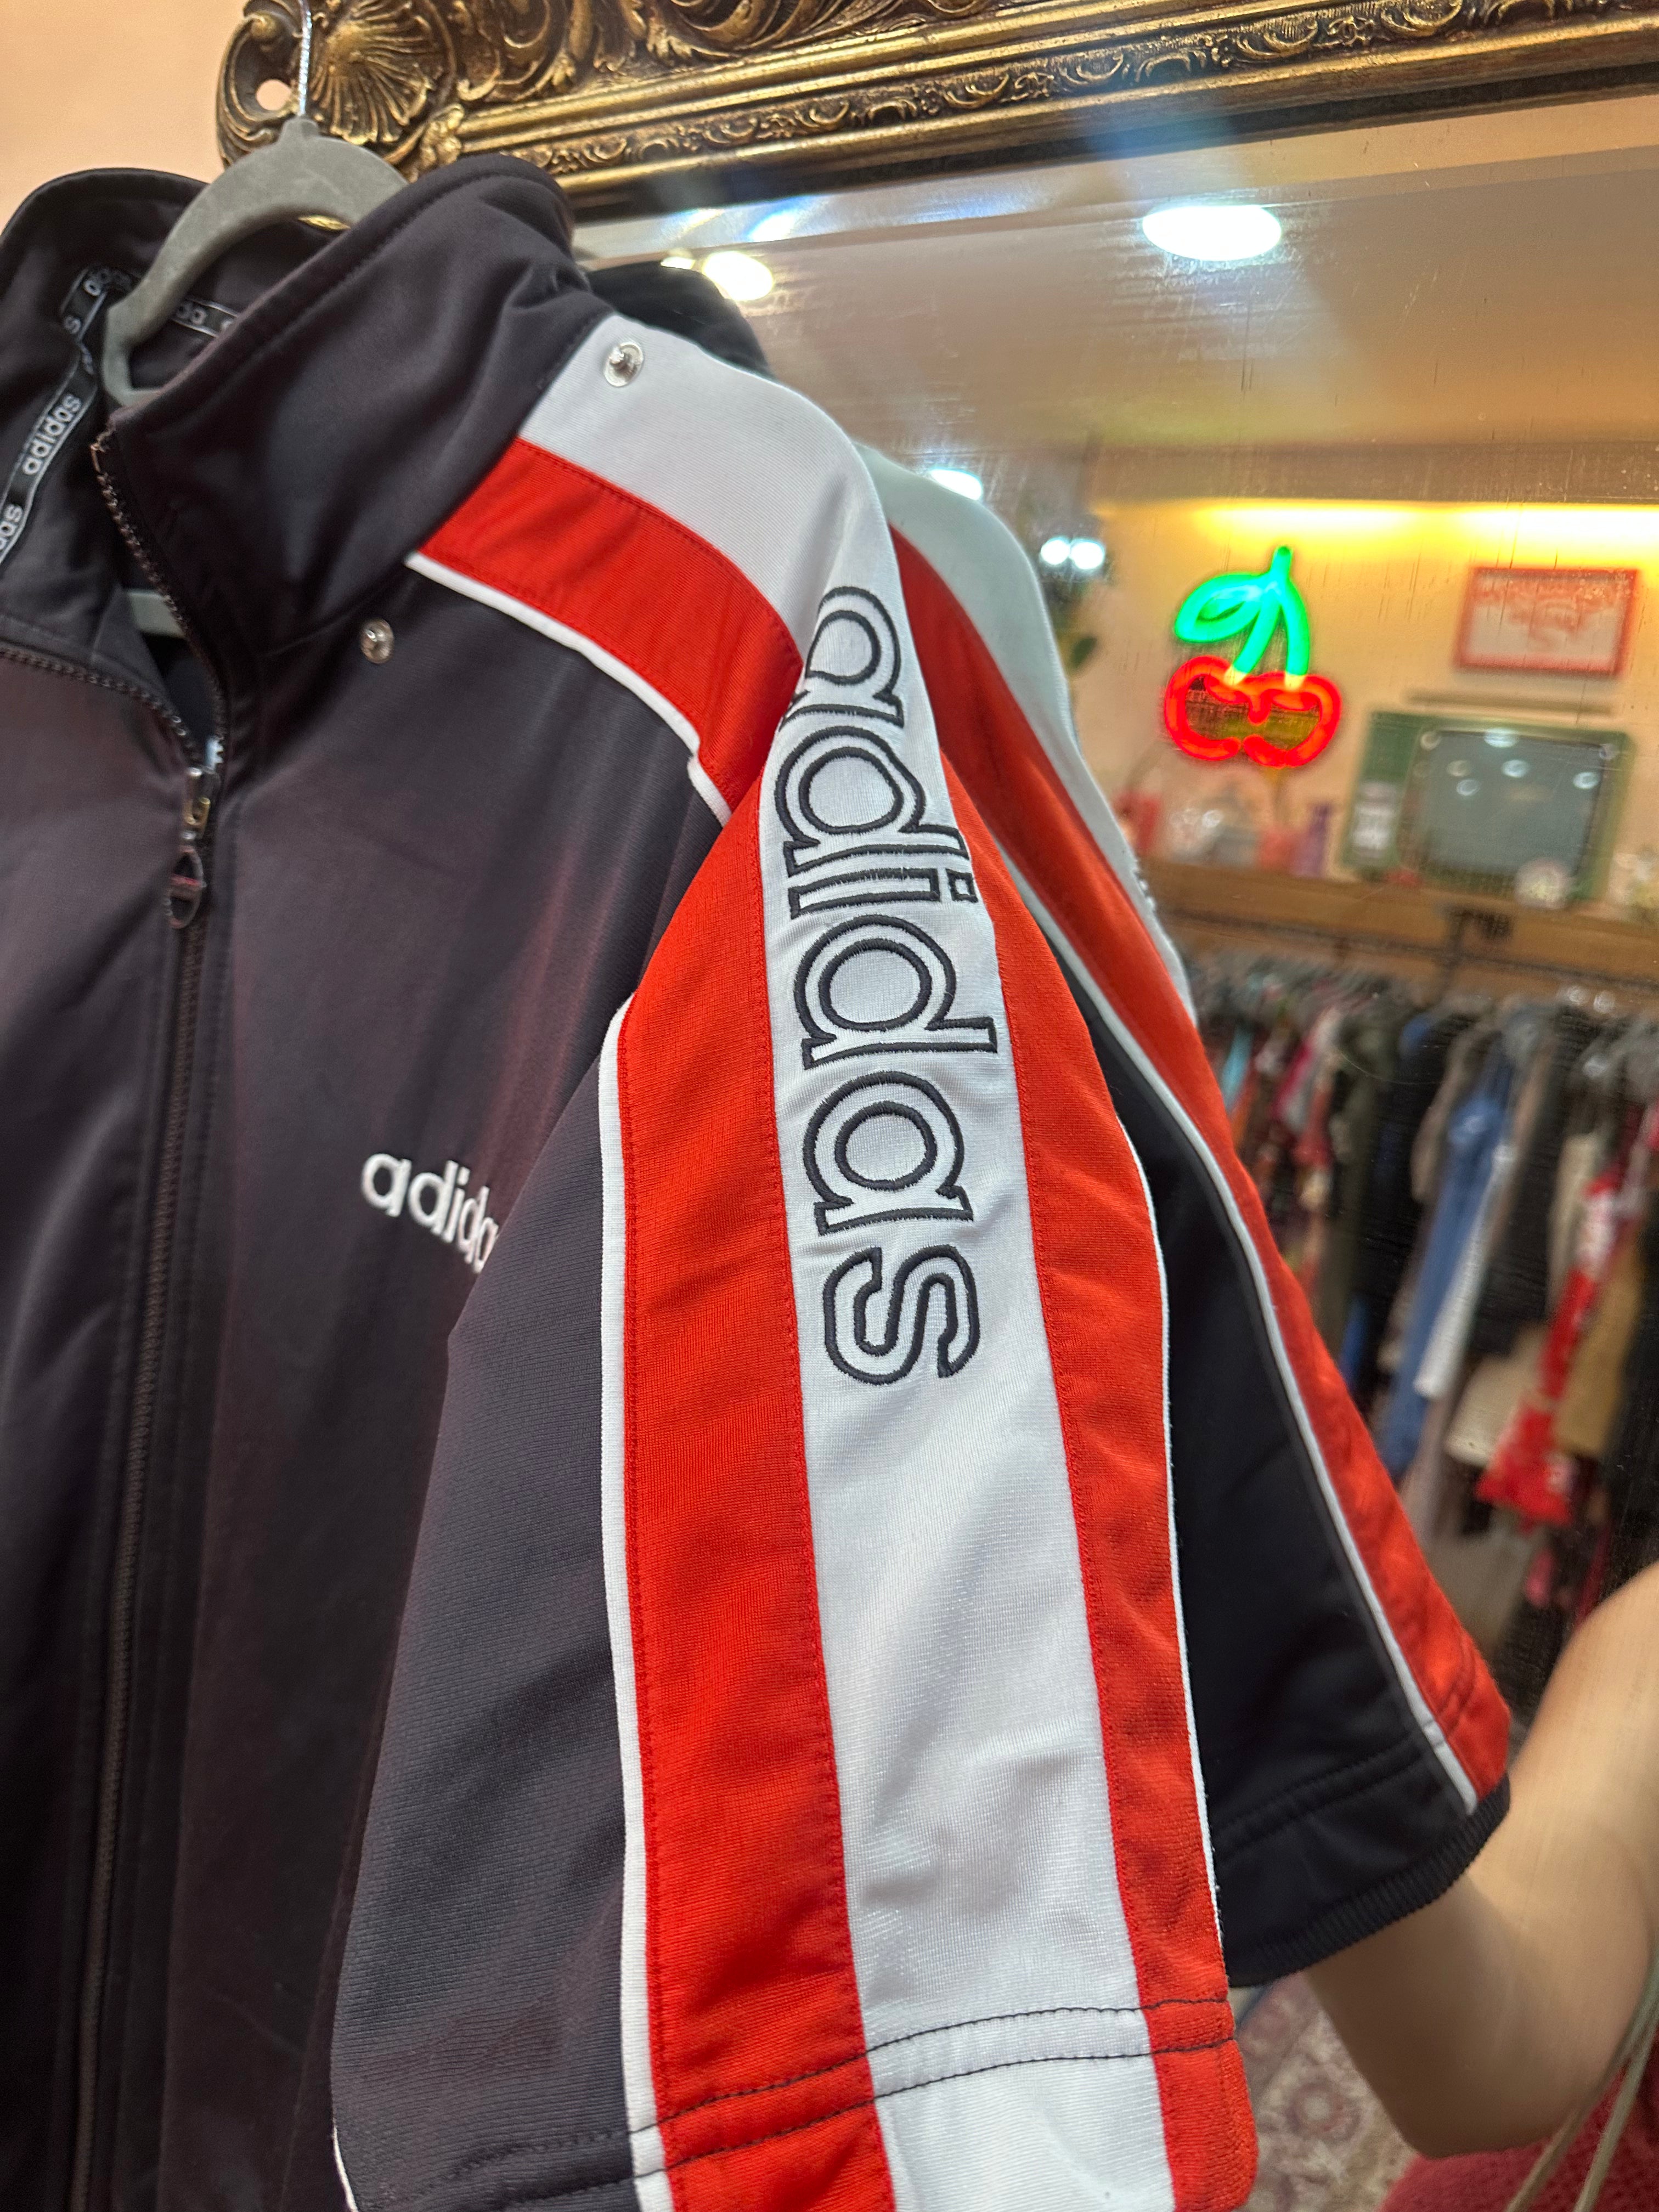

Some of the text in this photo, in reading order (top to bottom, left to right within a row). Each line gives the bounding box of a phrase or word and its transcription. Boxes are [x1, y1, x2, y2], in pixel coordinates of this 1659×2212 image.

[22, 393, 82, 475] adidas
[774, 585, 997, 1385] adidas
[361, 1153, 499, 1274] adida
